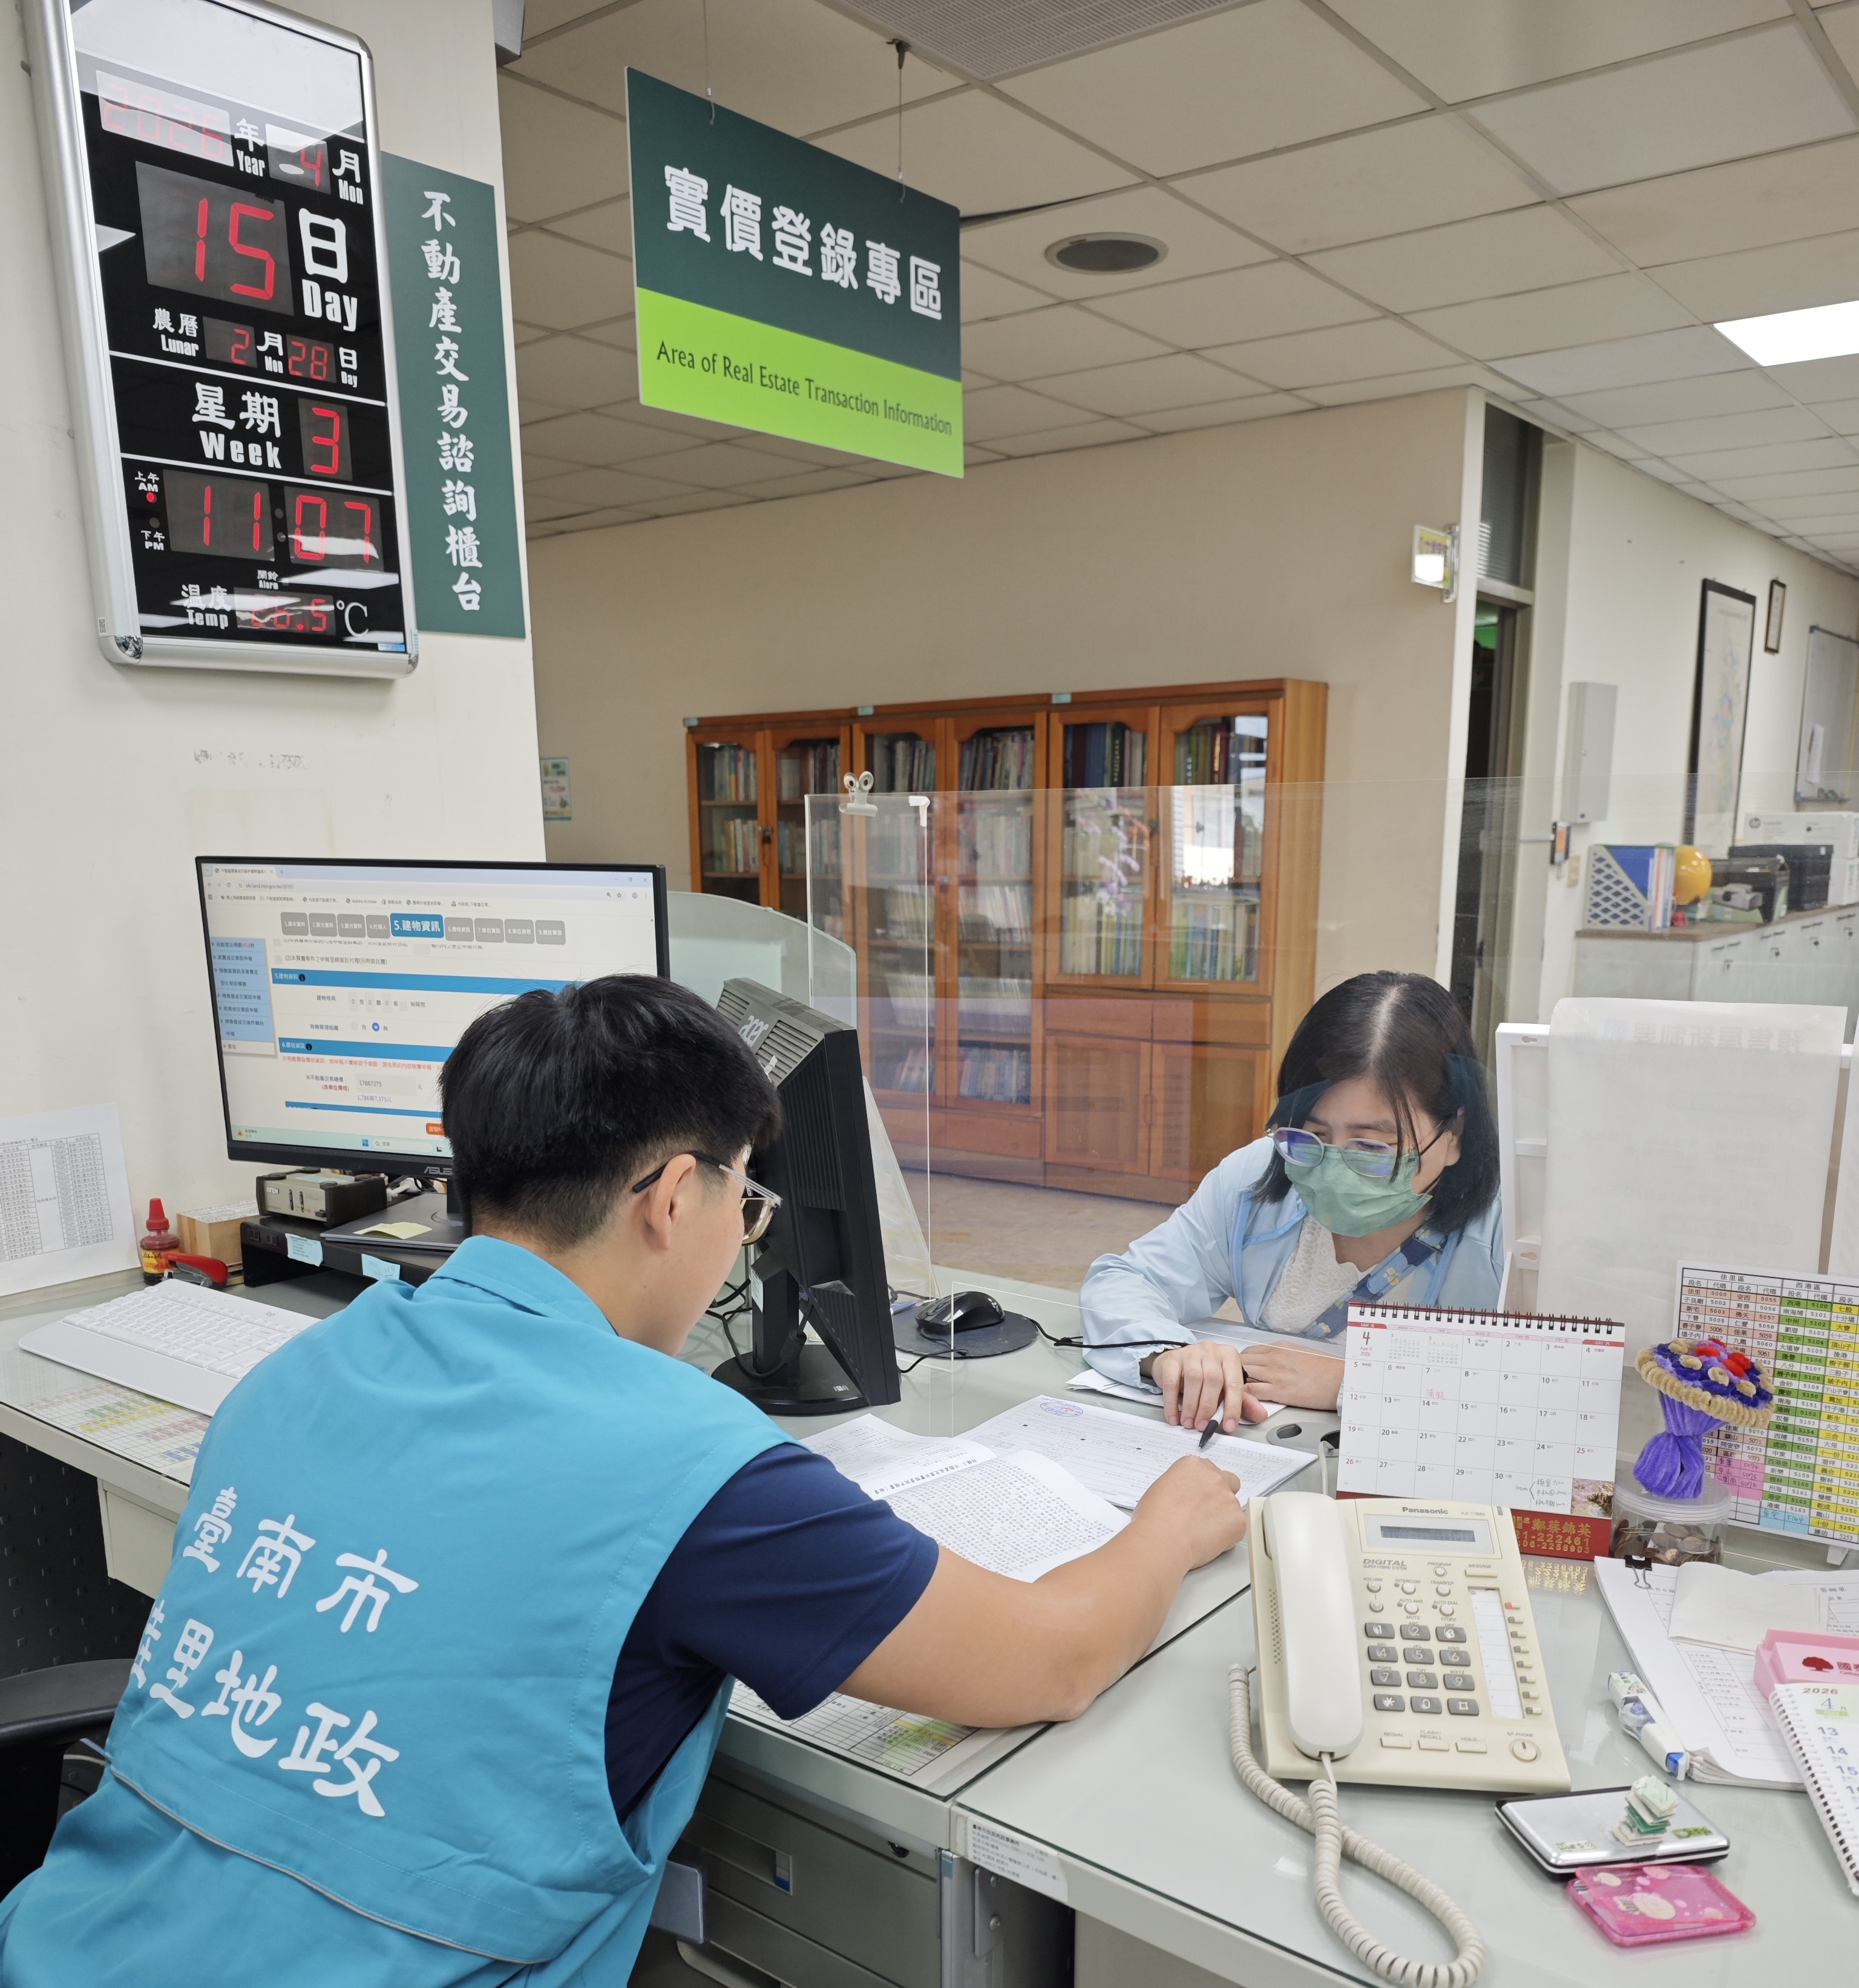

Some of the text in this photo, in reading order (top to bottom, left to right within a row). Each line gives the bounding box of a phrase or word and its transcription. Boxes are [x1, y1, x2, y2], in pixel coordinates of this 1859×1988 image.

[103, 85, 361, 187] 2026 年 4 月
[236, 149, 364, 205] Year Mon
[195, 197, 349, 301] 15 日
[664, 165, 943, 320] 實價登錄專區
[302, 280, 358, 332] Day
[152, 307, 358, 381] 農曆 2 月 28 日
[160, 334, 358, 388] Lunar Mon Day
[657, 341, 952, 437] Area of Real Estate Transaction Information
[420, 191, 484, 613] 不動產交易諮詢櫃台
[192, 381, 340, 474] 星期 3
[199, 430, 283, 470] Week
[134, 471, 159, 484] 上午
[138, 482, 159, 493] AM
[141, 530, 165, 542] 下午
[145, 541, 165, 551] PM
[259, 580, 279, 590] Alarm
[185, 608, 229, 630] Temp
[394, 919, 441, 933] 5.建物資訊
[424, 1166, 453, 1176] ASUS
[1720, 1273, 1745, 1282] 佳里區
[1795, 1282, 1821, 1291] 西港區
[1362, 1331, 1371, 1345] 4
[1402, 1506, 1449, 1515] Panasonic
[1531, 1518, 1592, 1538] 鄭蔡錦英
[183, 1486, 420, 1633] 臺南市
[1362, 1558, 1408, 1567] DIGITAL
[1411, 1627, 1420, 1636] 2
[1379, 1648, 1460, 1662] 4 5 6
[1383, 1672, 1464, 1687] 7 8 9
[1820, 1697, 1835, 1710] 4
[1817, 1726, 1839, 1737] 13
[1826, 1745, 1849, 1756] 14
[1836, 1765, 1859, 1776] 15
